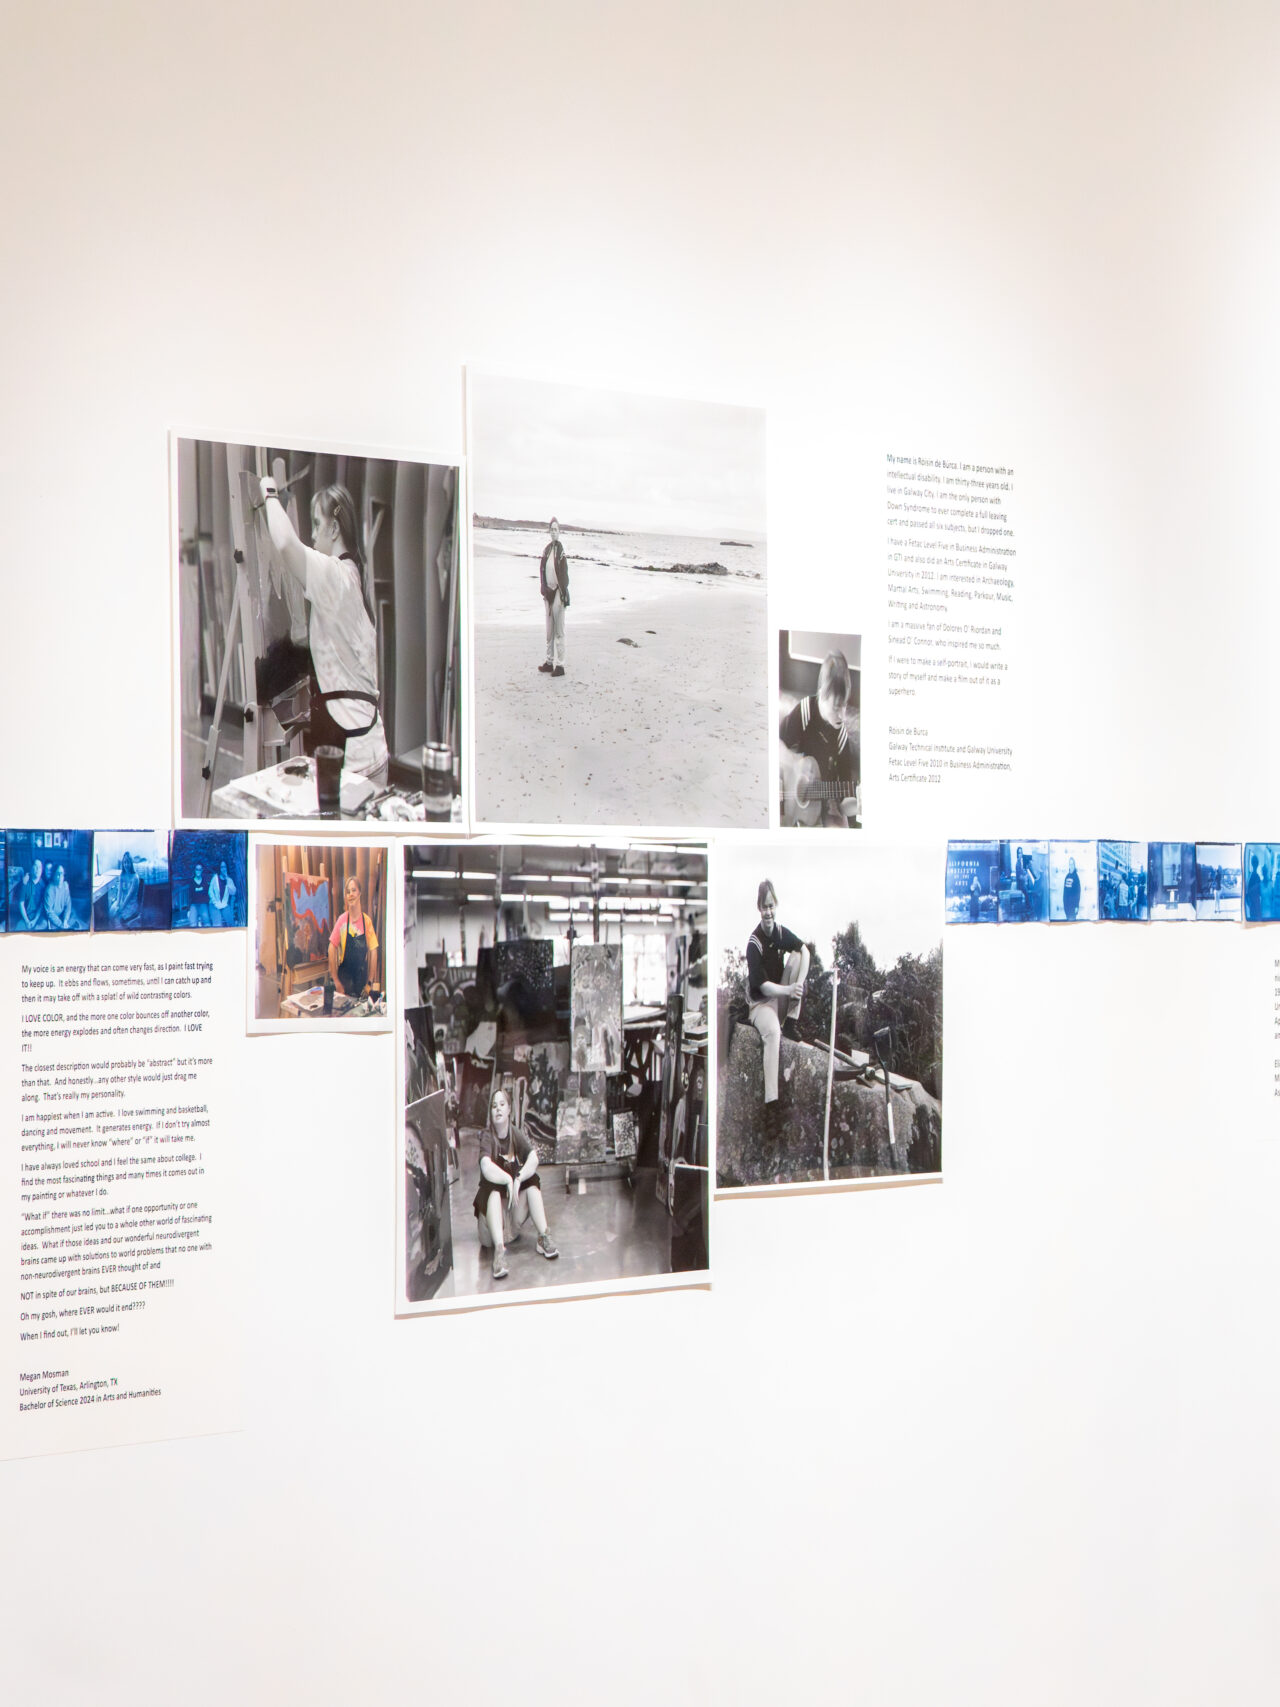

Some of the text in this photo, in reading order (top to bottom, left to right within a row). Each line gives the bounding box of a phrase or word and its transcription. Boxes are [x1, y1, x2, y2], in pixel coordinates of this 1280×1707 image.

[21, 965, 32, 974] My
[168, 962, 184, 972] paint
[196, 962, 214, 972] trying
[29, 979, 45, 989] keep
[64, 978, 79, 986] ebbs
[80, 978, 92, 986] and
[146, 977, 160, 985] until
[175, 976, 191, 984] catch
[200, 976, 212, 984] and
[57, 994, 71, 1002] take
[72, 993, 81, 1001] off
[81, 993, 95, 1001] with
[101, 992, 118, 1002] splat!
[119, 992, 126, 1000] of
[126, 992, 139, 1000] wild
[140, 991, 173, 1001] contrasting
[25, 1014, 41, 1022] LOVE
[66, 1013, 78, 1021] and
[120, 1012, 135, 1020] color
[161, 1010, 170, 1018] off
[170, 1010, 194, 1018] another
[21, 1029, 32, 1037] the
[72, 1027, 99, 1037] explodes
[100, 1026, 112, 1034] and
[129, 1026, 153, 1035] changes
[187, 1023, 203, 1032] LOVE
[20, 1261, 161, 1280] non-neurodivergent brains EVER thought of and
[20, 1291, 34, 1300] NOT
[42, 1289, 58, 1300] spite
[58, 1288, 66, 1296] of
[99, 1285, 110, 1293] but
[111, 1282, 138, 1292] BECAUSE
[139, 1282, 147, 1290] OF
[20, 1312, 30, 1320] Oh
[58, 1309, 78, 1317] where
[79, 1306, 95, 1315] EVER
[96, 1305, 115, 1314] would
[20, 1332, 39, 1341] When
[43, 1330, 56, 1339] find
[70, 1328, 78, 1336] I'll
[88, 1328, 100, 1337] you
[101, 1324, 120, 1333] know!
[19, 1371, 70, 1382] Megan Mosman
[19, 1386, 51, 1396] University
[51, 1384, 59, 1392] of
[110, 1378, 118, 1386] TX
[19, 1401, 47, 1411] Bachelor
[47, 1400, 55, 1408] of
[55, 1399, 79, 1407] Science
[79, 1395, 95, 1404] 2024
[102, 1394, 115, 1402] Arts
[116, 1391, 128, 1400] and
[128, 1388, 162, 1399] Humanities
